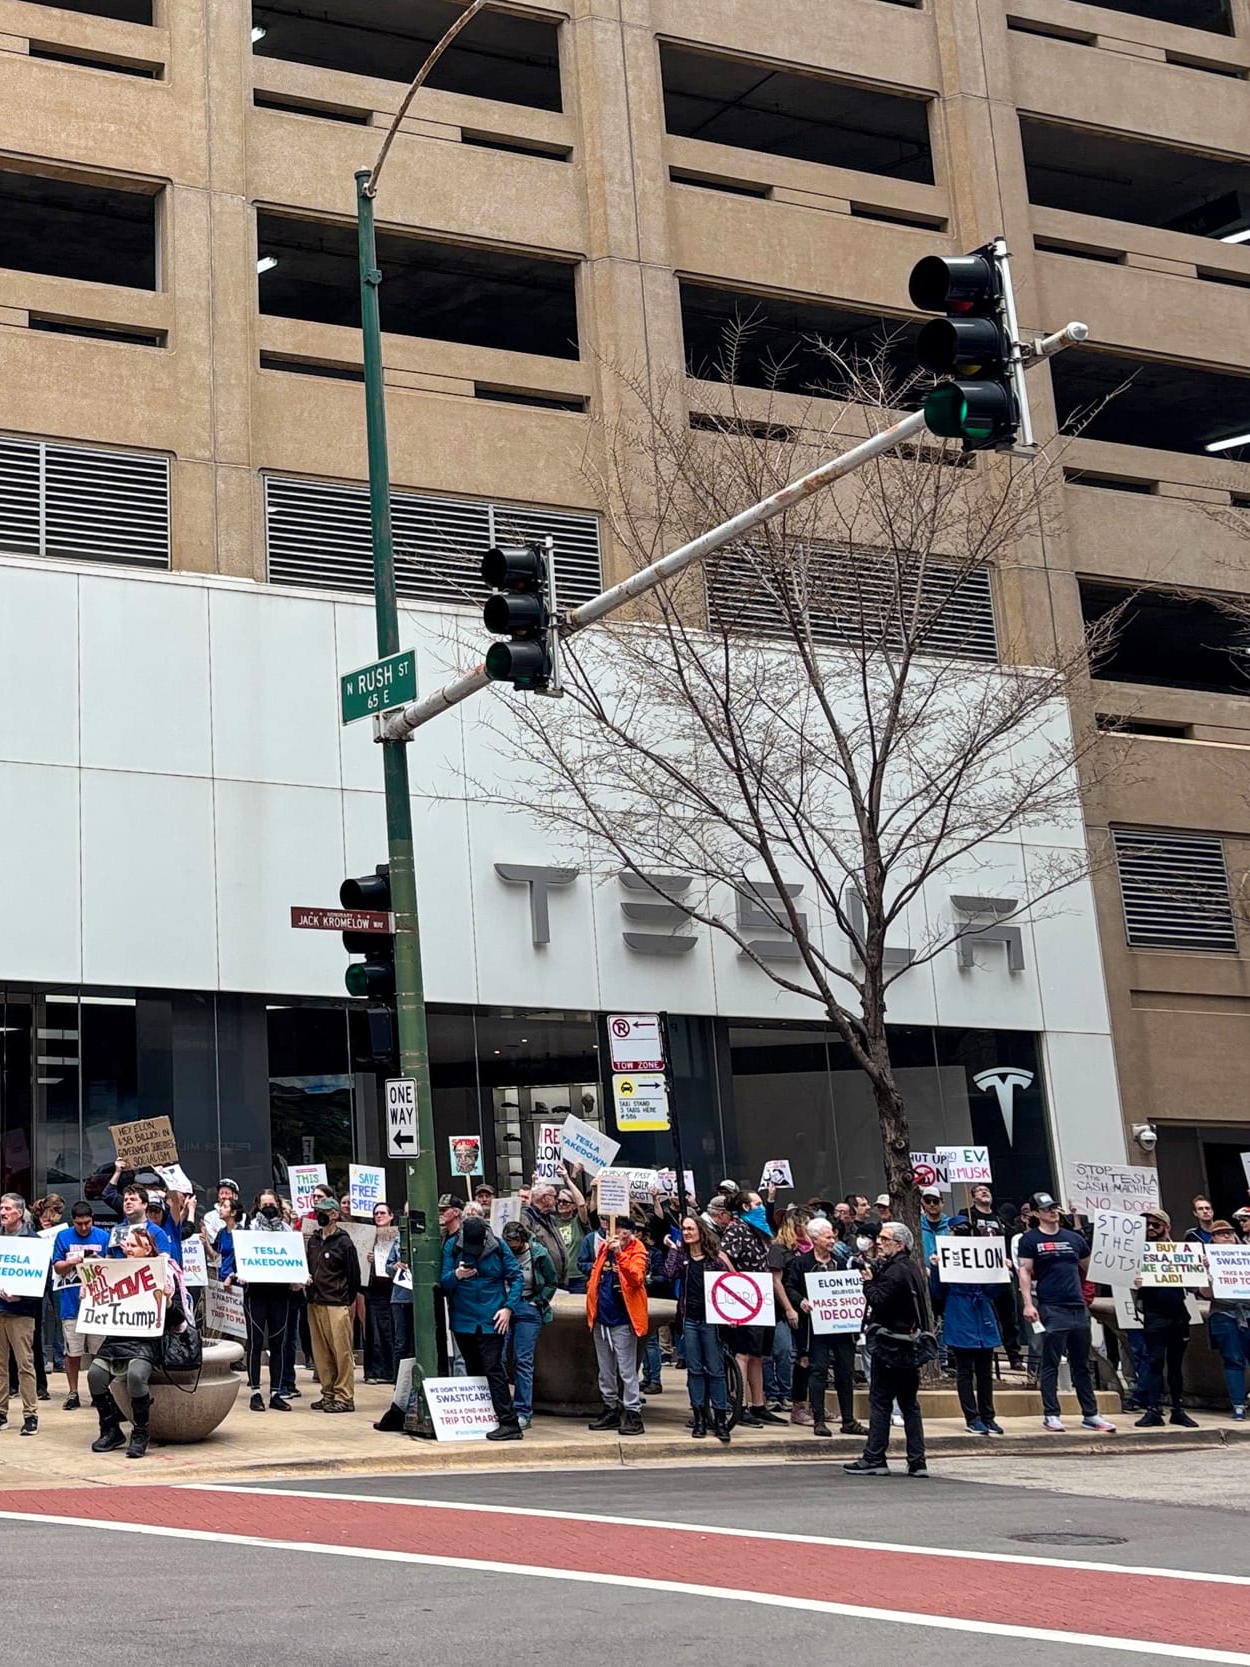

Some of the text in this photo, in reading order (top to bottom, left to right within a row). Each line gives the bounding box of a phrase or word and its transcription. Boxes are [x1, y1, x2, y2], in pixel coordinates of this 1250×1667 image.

[347, 661, 409, 696] N RUSH ST
[367, 690, 389, 709] 65 E
[298, 915, 319, 926] JACK
[323, 916, 369, 929] KROMELOW
[493, 862, 1025, 971] TESLA
[637, 1061, 660, 1069] ZONE
[389, 1086, 413, 1104] ONE
[390, 1107, 414, 1126] WAY
[118, 1121, 155, 1136] HEY ELON
[575, 1133, 600, 1154] TESLA
[562, 1135, 607, 1167] TAKEDOWN
[133, 1151, 170, 1167] SOCIALISM
[911, 1154, 947, 1164] HUT UP
[957, 1166, 990, 1179] MUSK
[1077, 1163, 1113, 1176] STOP
[296, 1174, 319, 1184] THIS
[359, 1173, 380, 1186] SAVE
[630, 1180, 650, 1189] ASTER
[1109, 1173, 1158, 1186] TESLA
[297, 1185, 314, 1194] MUS
[351, 1184, 378, 1198] FREE
[1076, 1181, 1157, 1196] CASH MACHINE
[351, 1199, 376, 1211] SPEEC
[1086, 1196, 1111, 1210] NO
[1097, 1214, 1143, 1236] STOP
[1100, 1233, 1134, 1252] THE
[1156, 1243, 1192, 1252] BUY A
[254, 1246, 288, 1256] TESLA
[241, 1258, 303, 1267] TAKEDOWN
[1094, 1251, 1141, 1274] CUTS!
[1144, 1254, 1202, 1264] ESLA, BUT I
[1141, 1264, 1205, 1273] KE GETTING
[818, 1278, 863, 1288] ELON MUS
[1154, 1274, 1183, 1283] LAID!
[1218, 1277, 1238, 1285] TRIP
[92, 1265, 156, 1307] REMOVE
[211, 1292, 243, 1306] SWASTICA
[813, 1296, 865, 1307] MASS SHOO
[83, 1308, 108, 1325] Der
[227, 1313, 234, 1321] TO
[236, 1317, 245, 1325] MA
[820, 1309, 864, 1320] IDEOLO
[436, 1392, 491, 1403] SWASTICARS
[439, 1415, 499, 1425] TRIP TO MARS
